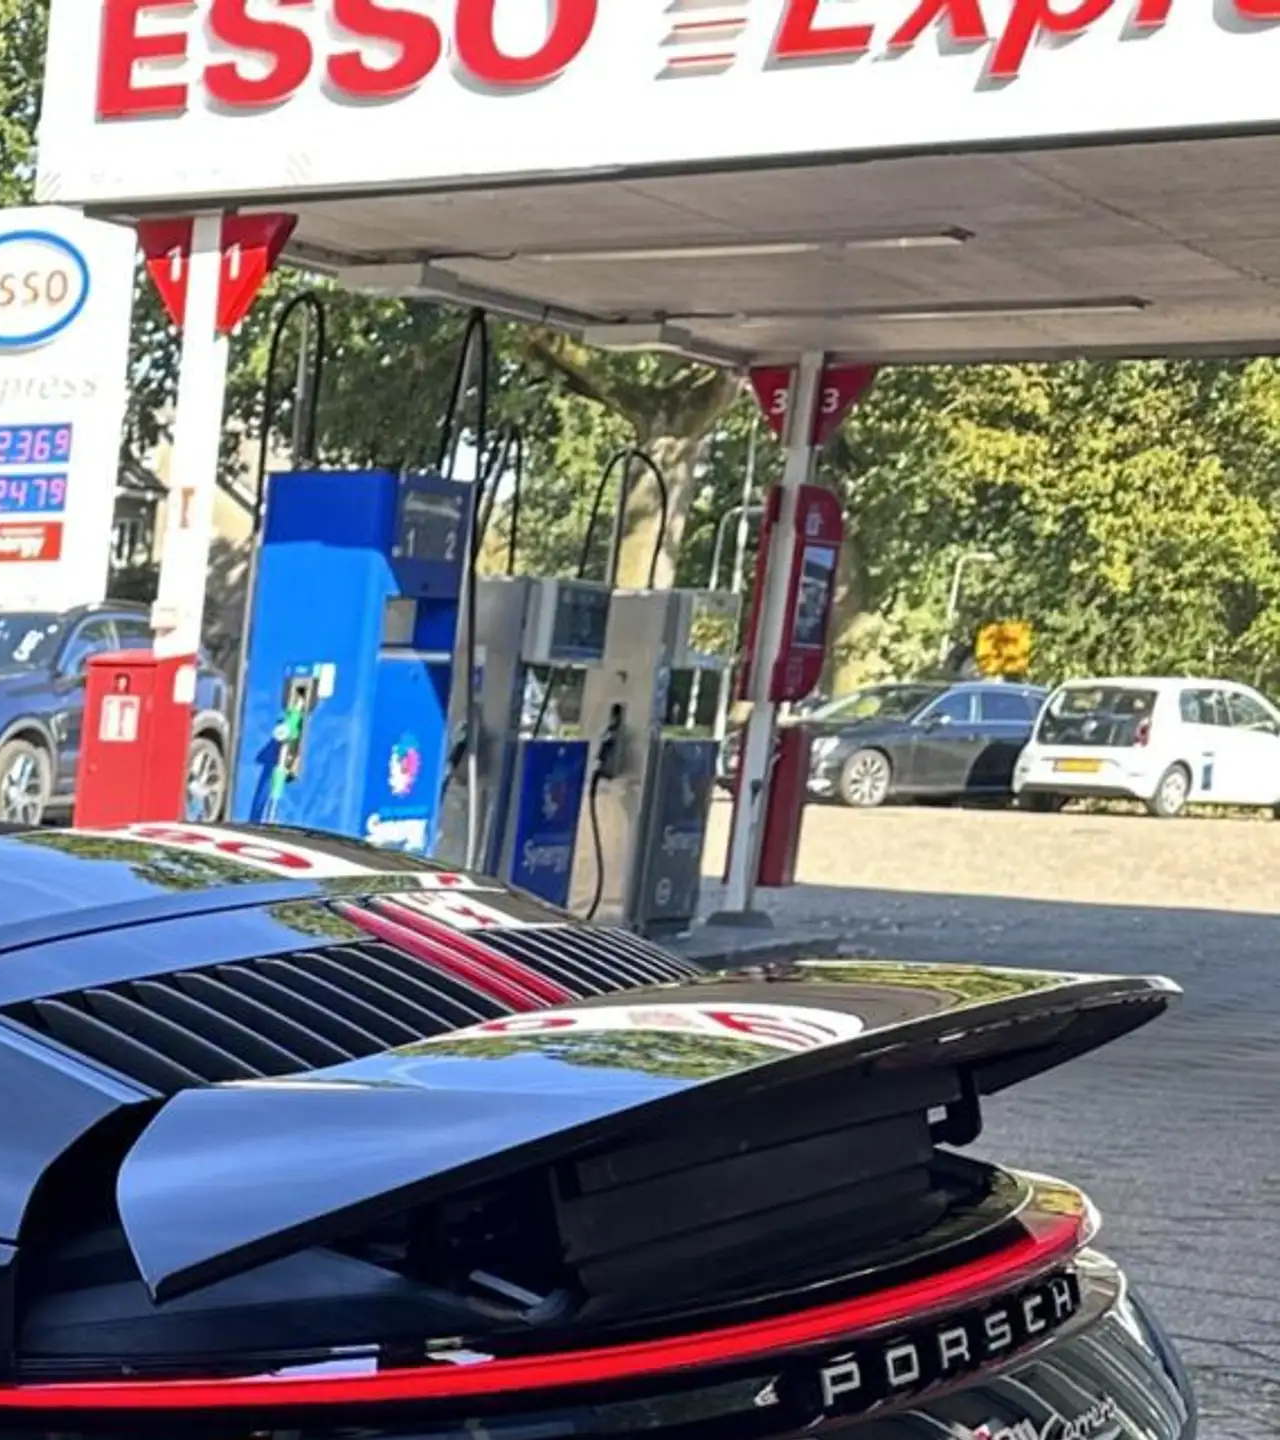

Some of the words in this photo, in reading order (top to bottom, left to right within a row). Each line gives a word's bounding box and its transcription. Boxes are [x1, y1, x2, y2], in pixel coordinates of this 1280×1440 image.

[167, 245, 183, 283] 1
[224, 243, 241, 280] 1
[770, 388, 789, 414] 3
[821, 387, 840, 413] 3
